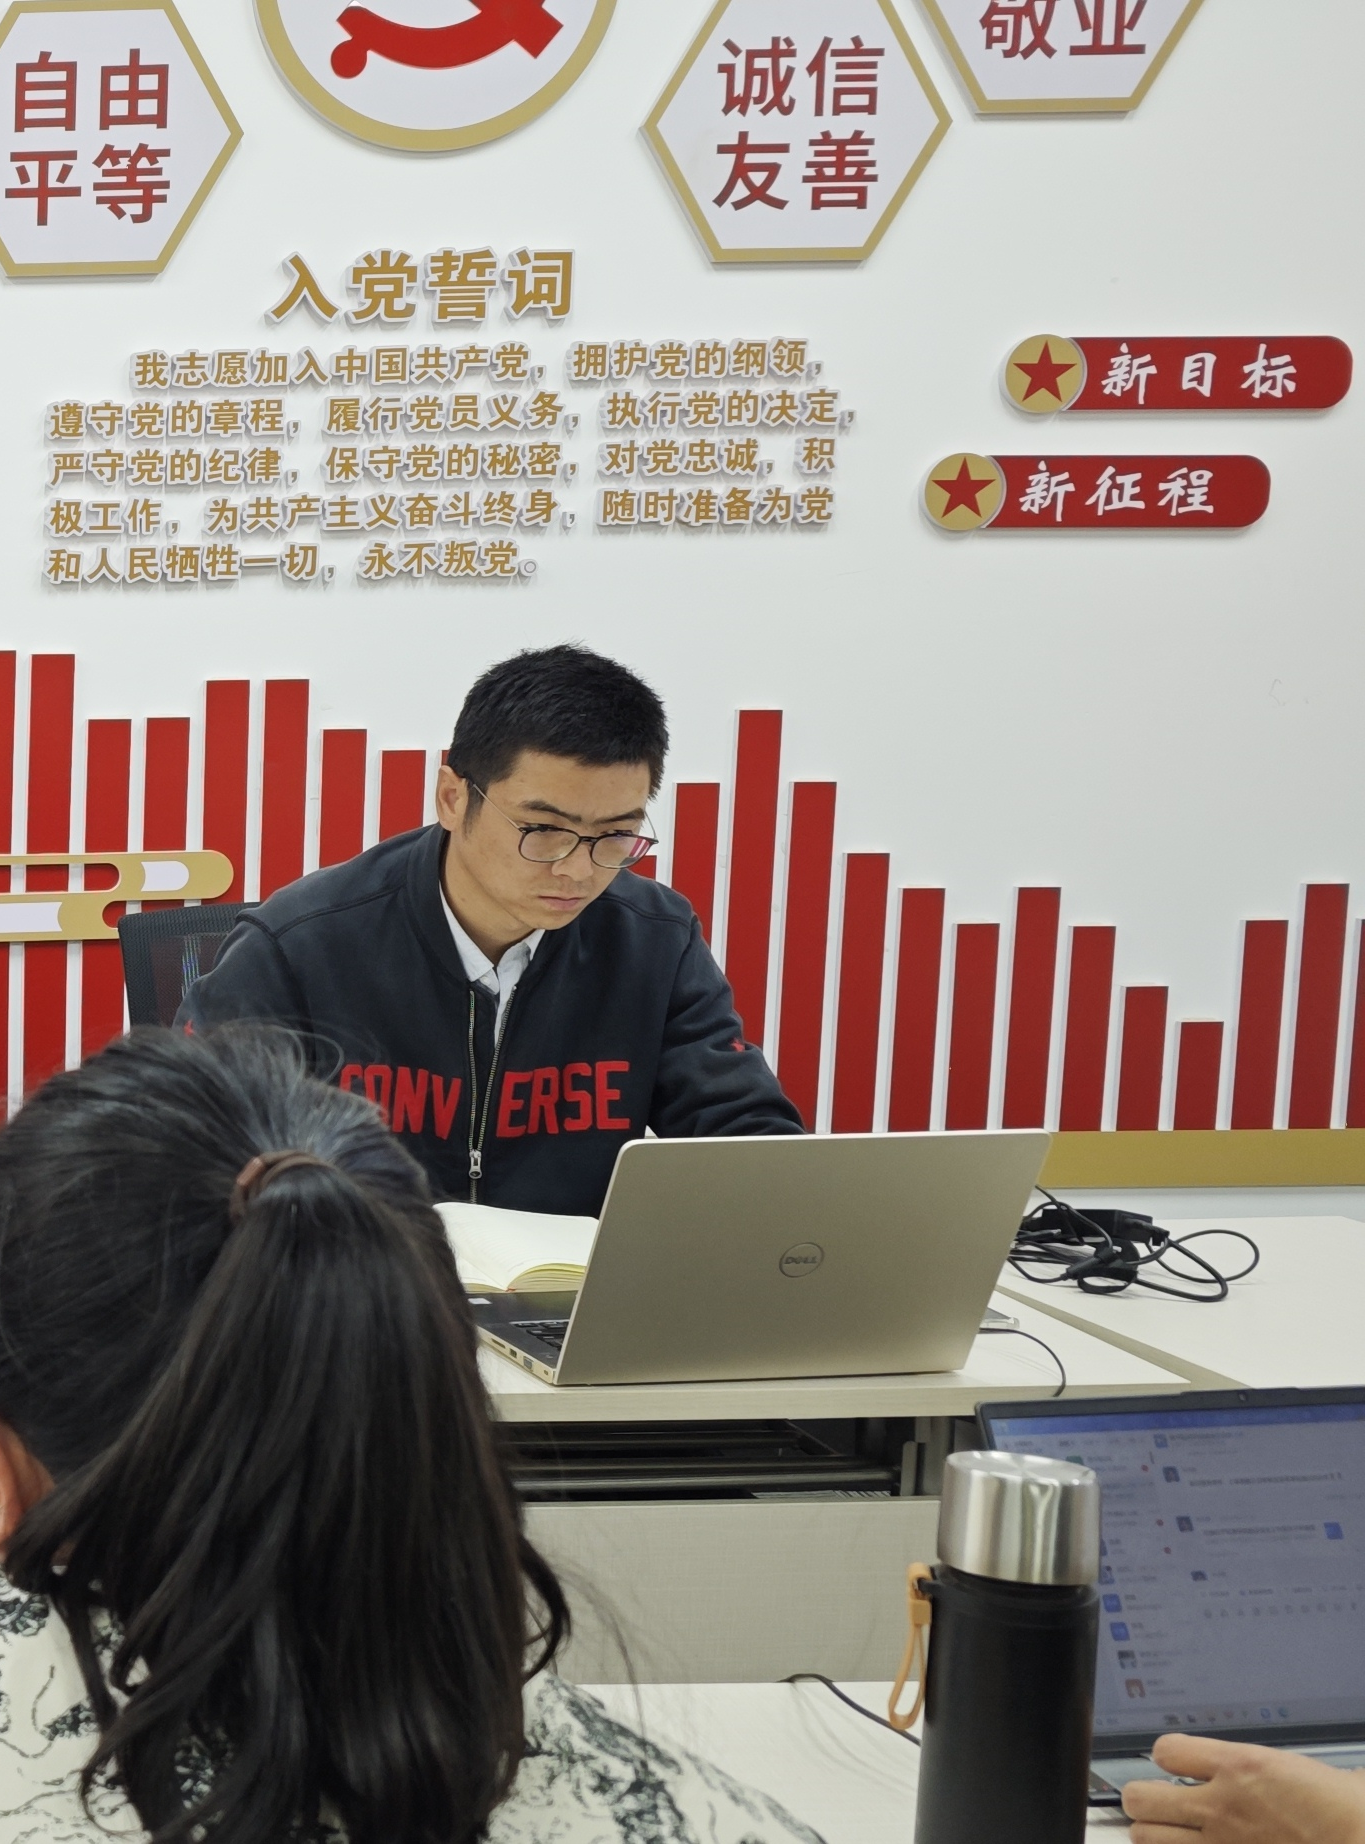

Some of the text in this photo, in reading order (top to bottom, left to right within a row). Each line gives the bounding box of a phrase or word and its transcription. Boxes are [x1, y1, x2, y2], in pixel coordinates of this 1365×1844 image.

[979, 0, 1146, 61] 敬业
[14, 48, 170, 133] 自由
[717, 35, 885, 119] 诚信
[4, 142, 171, 227] 平等
[712, 130, 879, 213] 友善
[271, 249, 575, 321] 入党誓词
[135, 339, 823, 388] 我志愿加入中国共产党，拥护党的纲领，
[1100, 342, 1297, 404] 新目标
[49, 390, 856, 440] 遵守党的章程，履行党员义务，执行党的决定，
[49, 437, 836, 485] 严守党的纪律，保守党的秘密，对党忠诚，积
[1019, 461, 1213, 521] 新征程
[49, 487, 835, 535] 极工作，为共产主义奋斗终身，随时准备为党
[49, 539, 538, 583] 和人民牺牲一切，永不叛党。
